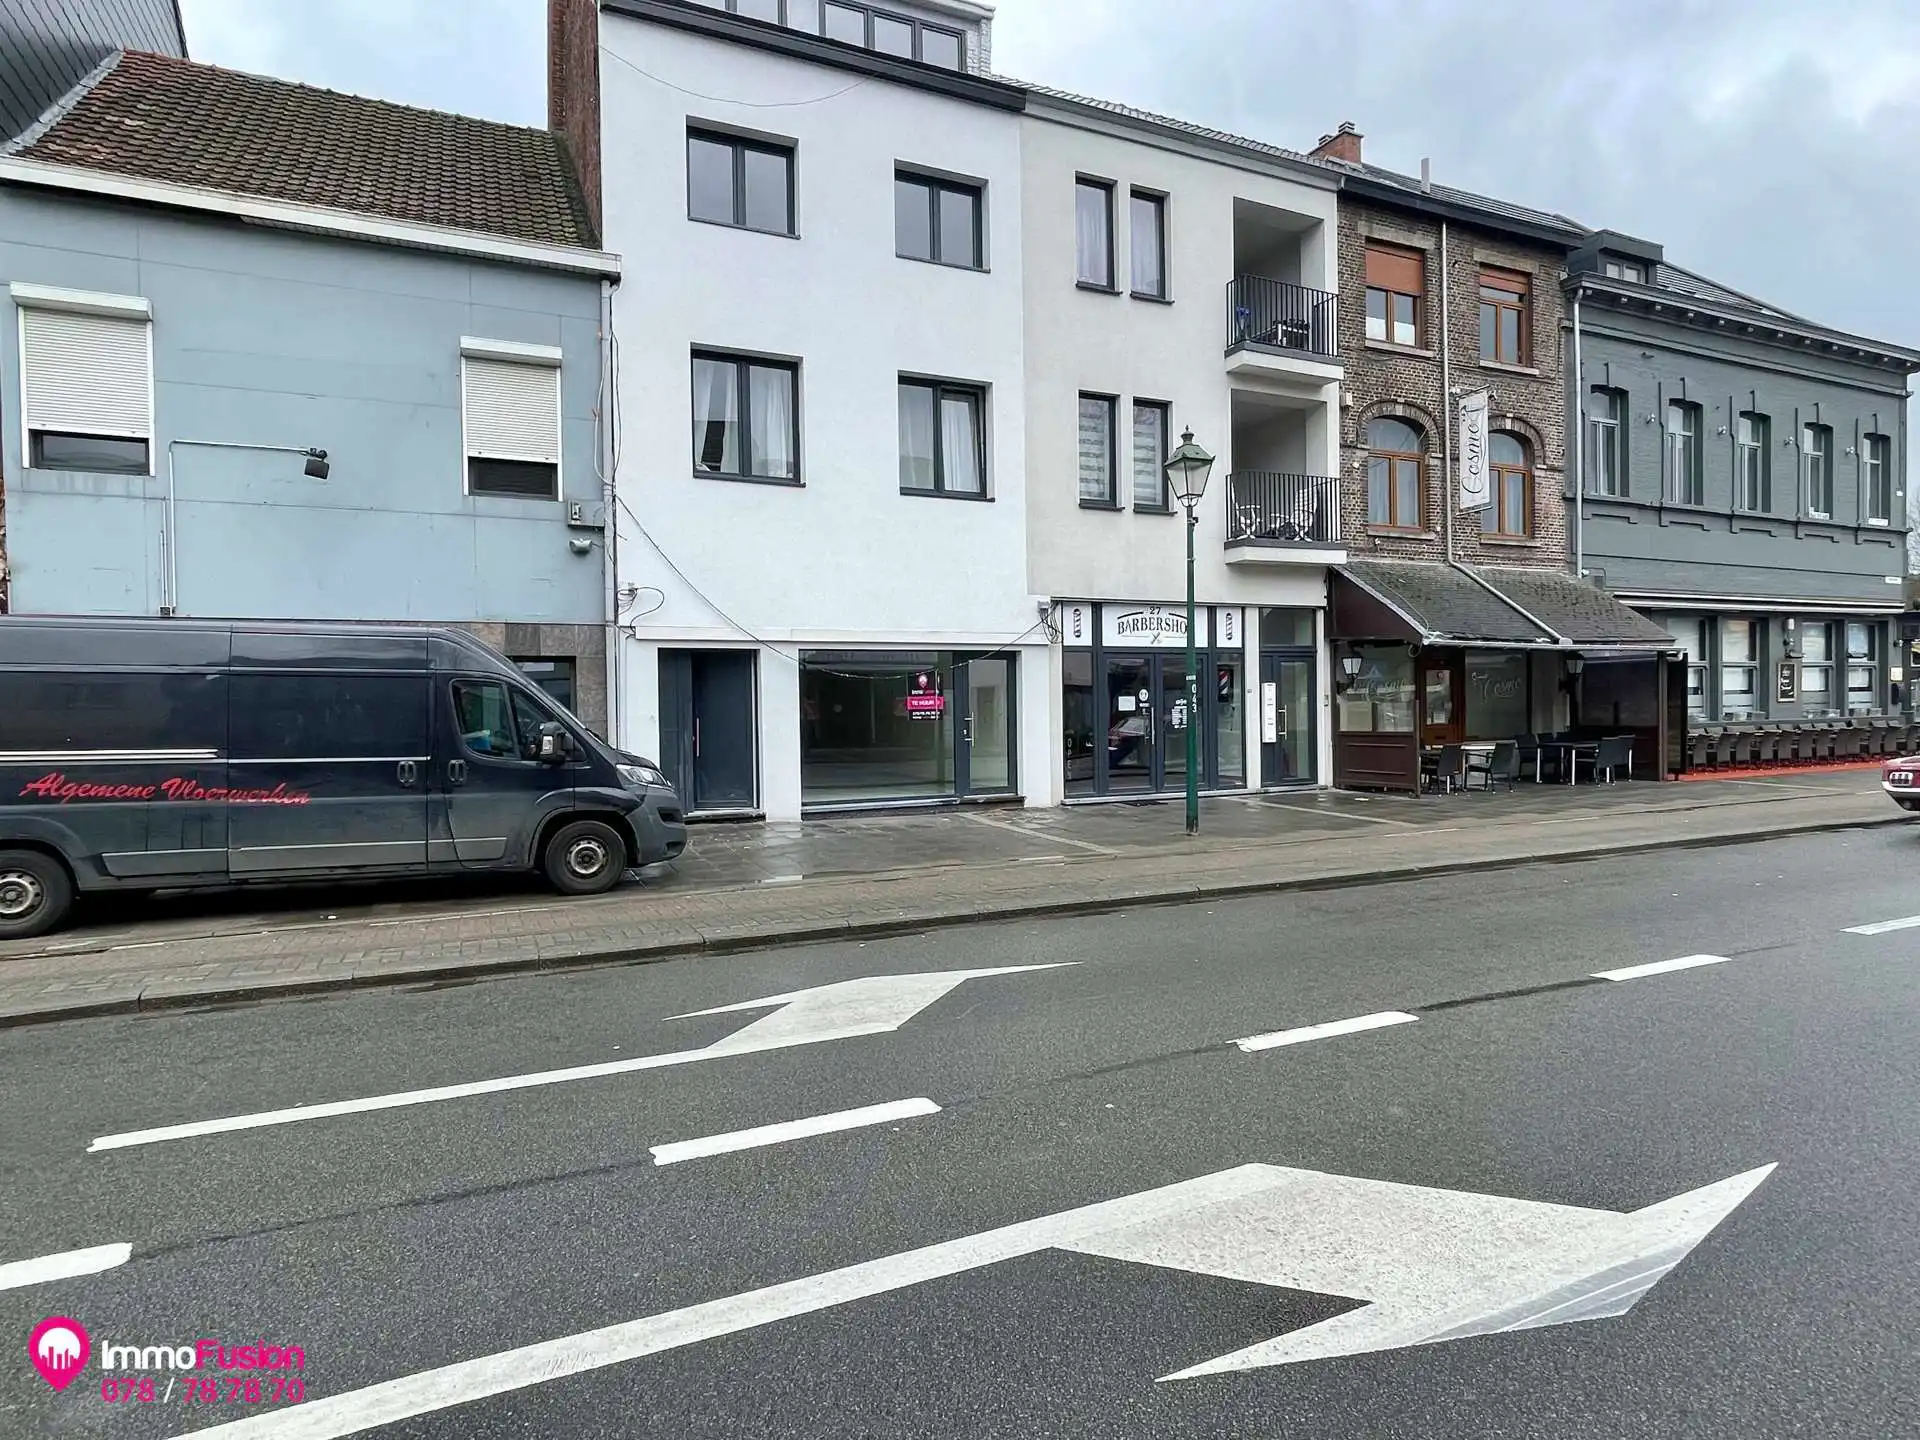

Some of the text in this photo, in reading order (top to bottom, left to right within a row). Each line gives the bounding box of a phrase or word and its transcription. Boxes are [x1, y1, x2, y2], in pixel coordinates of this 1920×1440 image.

[1149, 606, 1161, 615] 27
[19, 772, 310, 804] Algemene Vloerwerken
